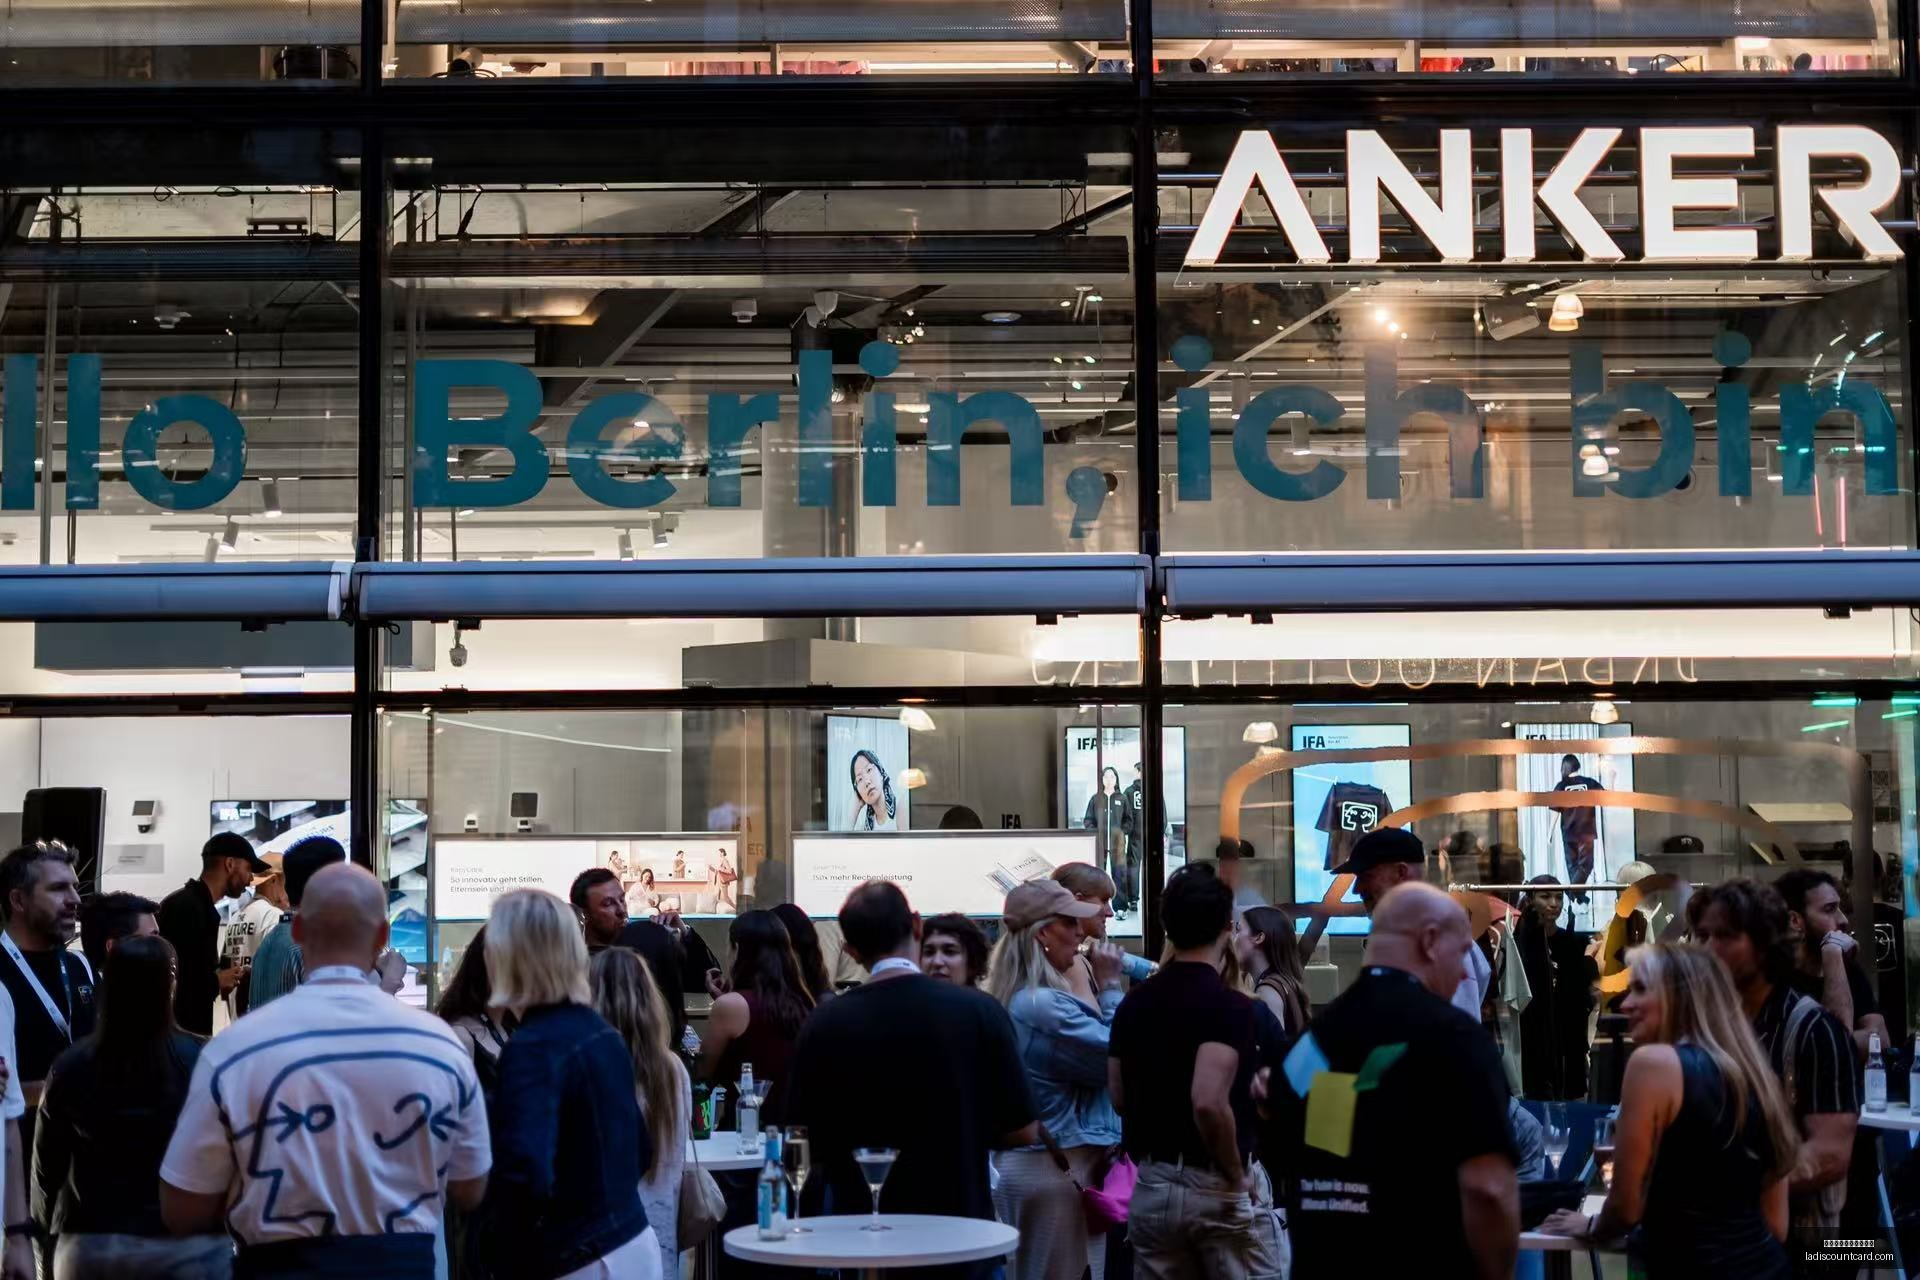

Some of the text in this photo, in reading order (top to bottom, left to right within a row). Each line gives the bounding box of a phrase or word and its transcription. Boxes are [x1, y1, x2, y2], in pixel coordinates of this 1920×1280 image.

[1185, 125, 1905, 264] ANKER
[413, 339, 1106, 538] Berlin,
[1169, 333, 1485, 501] ich
[1569, 331, 1900, 499] bin
[1302, 735, 1326, 748] IFA
[1001, 813, 1022, 829] IFA
[498, 876, 517, 885] geht
